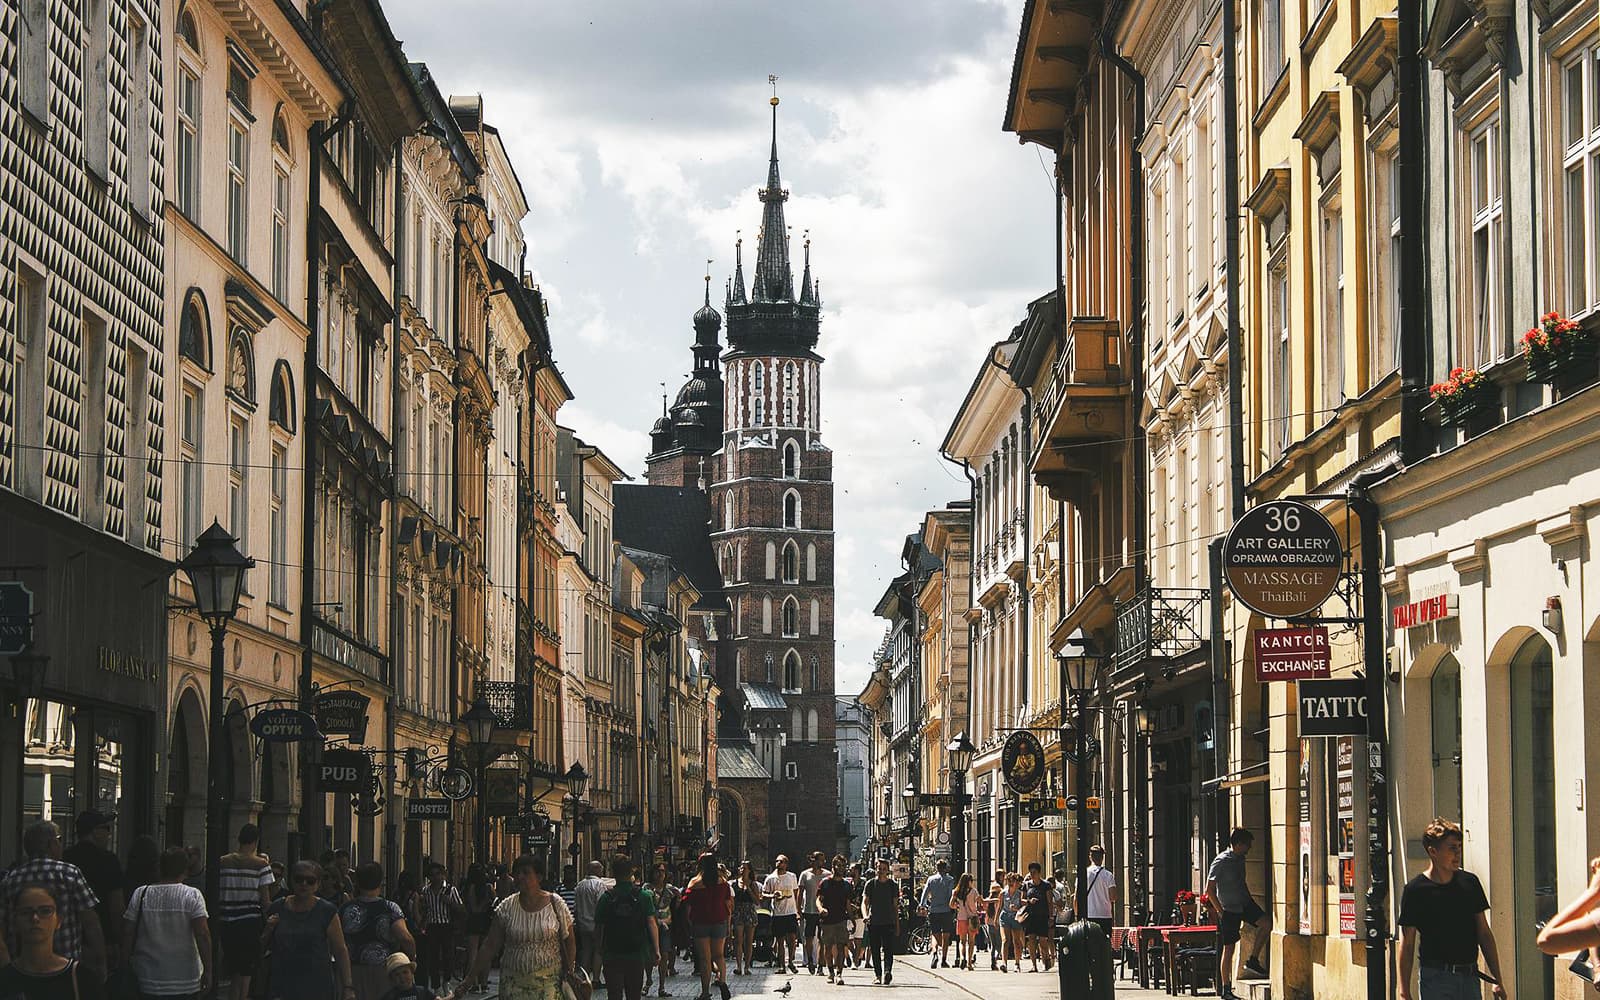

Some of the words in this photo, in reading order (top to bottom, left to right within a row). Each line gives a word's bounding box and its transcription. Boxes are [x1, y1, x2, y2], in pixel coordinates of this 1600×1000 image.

[1265, 506, 1300, 532] 36
[1236, 538, 1263, 549] ART
[1267, 538, 1331, 549] GALLERY
[1232, 554, 1278, 563] OPRAWA
[1280, 553, 1335, 563] OBRAZÓW
[1243, 572, 1323, 585] MASSAGE
[1260, 591, 1307, 602] ThaiBali
[1260, 635, 1324, 649] KANTOR
[1262, 659, 1326, 673] EXCHANGE
[1303, 696, 1367, 719] TATTO
[262, 725, 303, 736] OPTYK
[321, 767, 358, 781] PUB
[410, 804, 449, 814] HOSTEL
